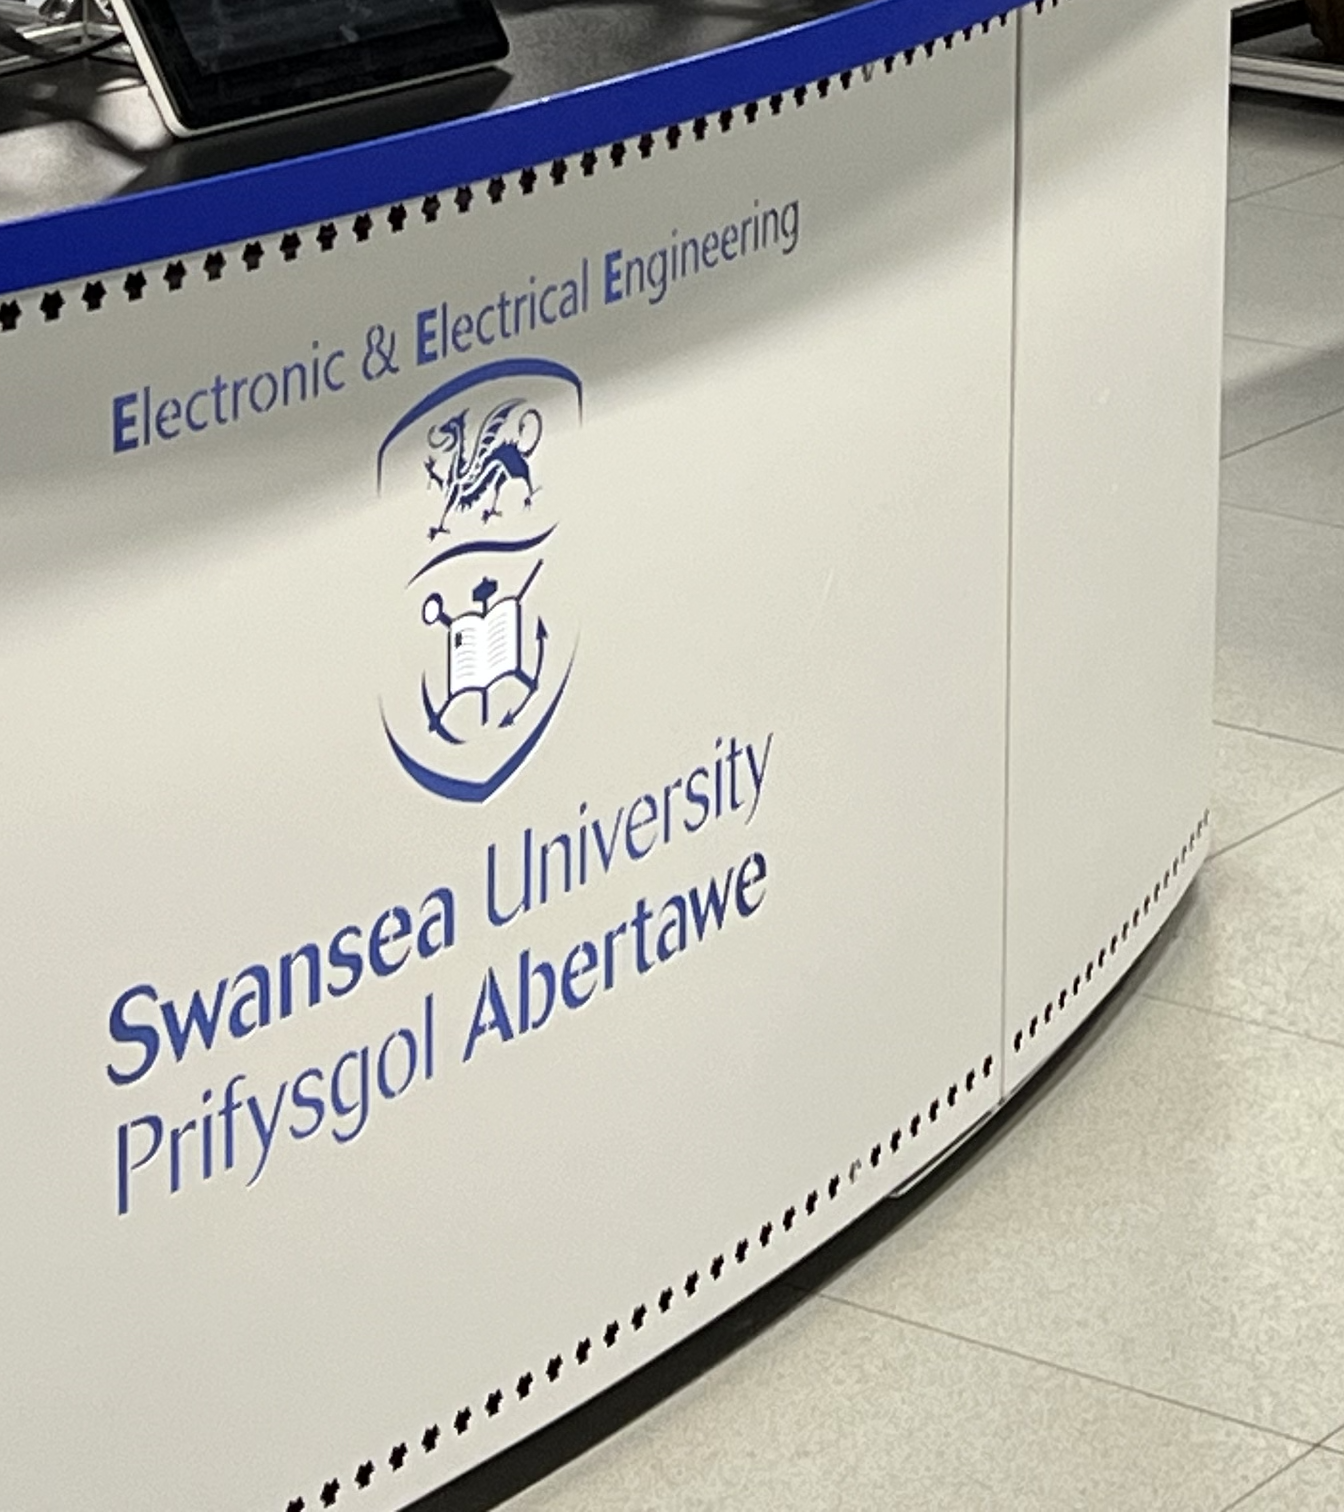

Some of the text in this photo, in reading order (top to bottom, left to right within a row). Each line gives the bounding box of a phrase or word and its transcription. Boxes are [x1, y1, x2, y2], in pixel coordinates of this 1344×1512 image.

[111, 198, 801, 455] Electronic & Electrical Engineering
[107, 731, 773, 1086] Swansea University
[117, 849, 769, 1217] Prifysgol Abertawe
